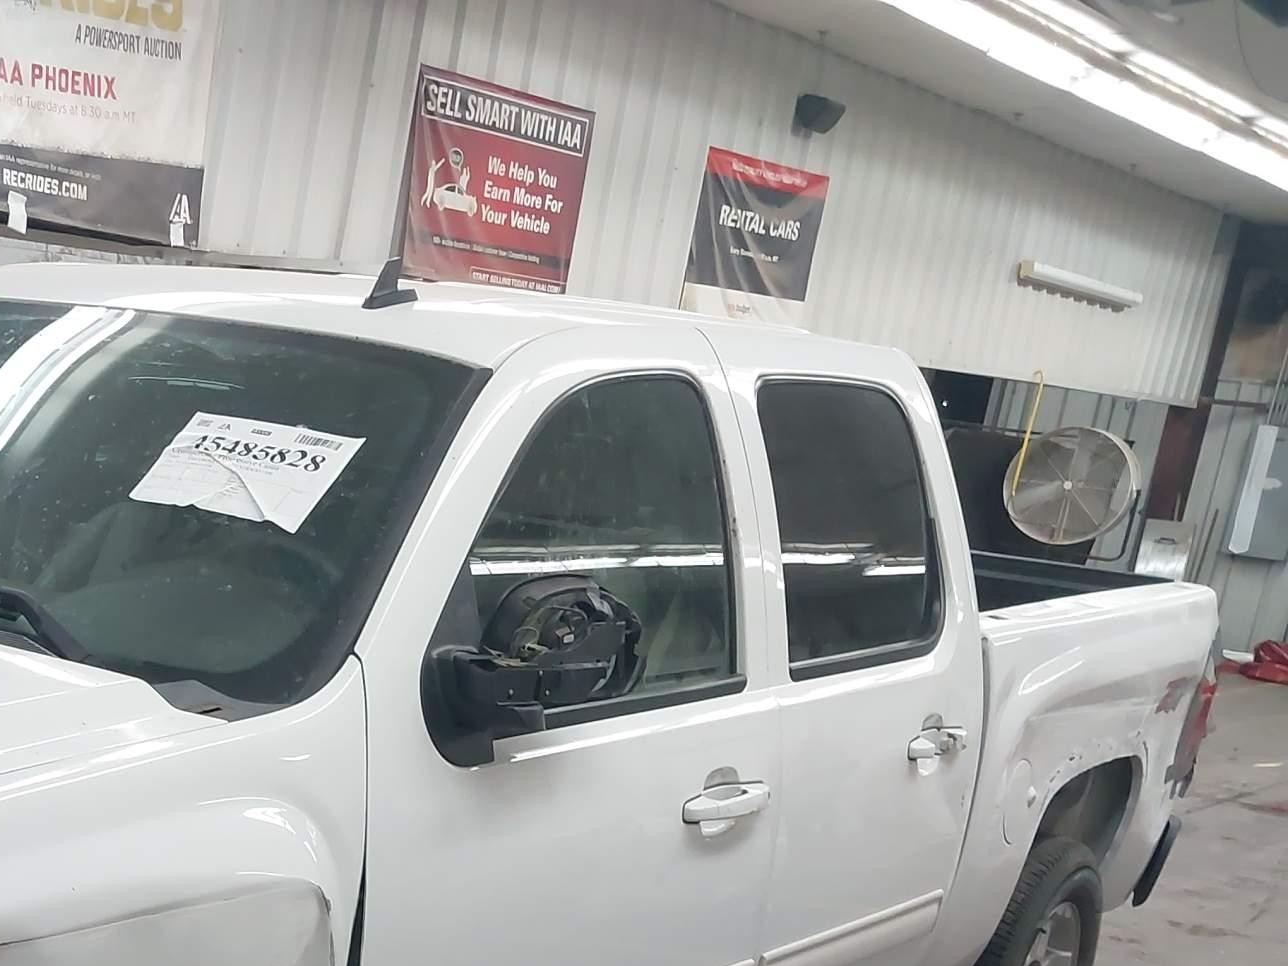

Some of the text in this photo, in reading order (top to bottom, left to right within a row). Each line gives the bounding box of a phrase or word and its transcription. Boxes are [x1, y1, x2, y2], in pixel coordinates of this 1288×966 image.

[75, 23, 182, 60] A POWERSPORT AUCTION
[31, 63, 117, 100] PHOENIX
[26, 95, 67, 115] Tuesdays
[426, 83, 582, 149] SELL SMART WITH IAA
[2, 167, 88, 201] RECRIDES.COM
[487, 154, 506, 177] We
[508, 160, 534, 187] Help
[538, 167, 558, 189] You
[483, 180, 563, 214] Earn More For
[480, 203, 551, 235] Your Vehicle
[718, 204, 801, 241] RENTAL CARS
